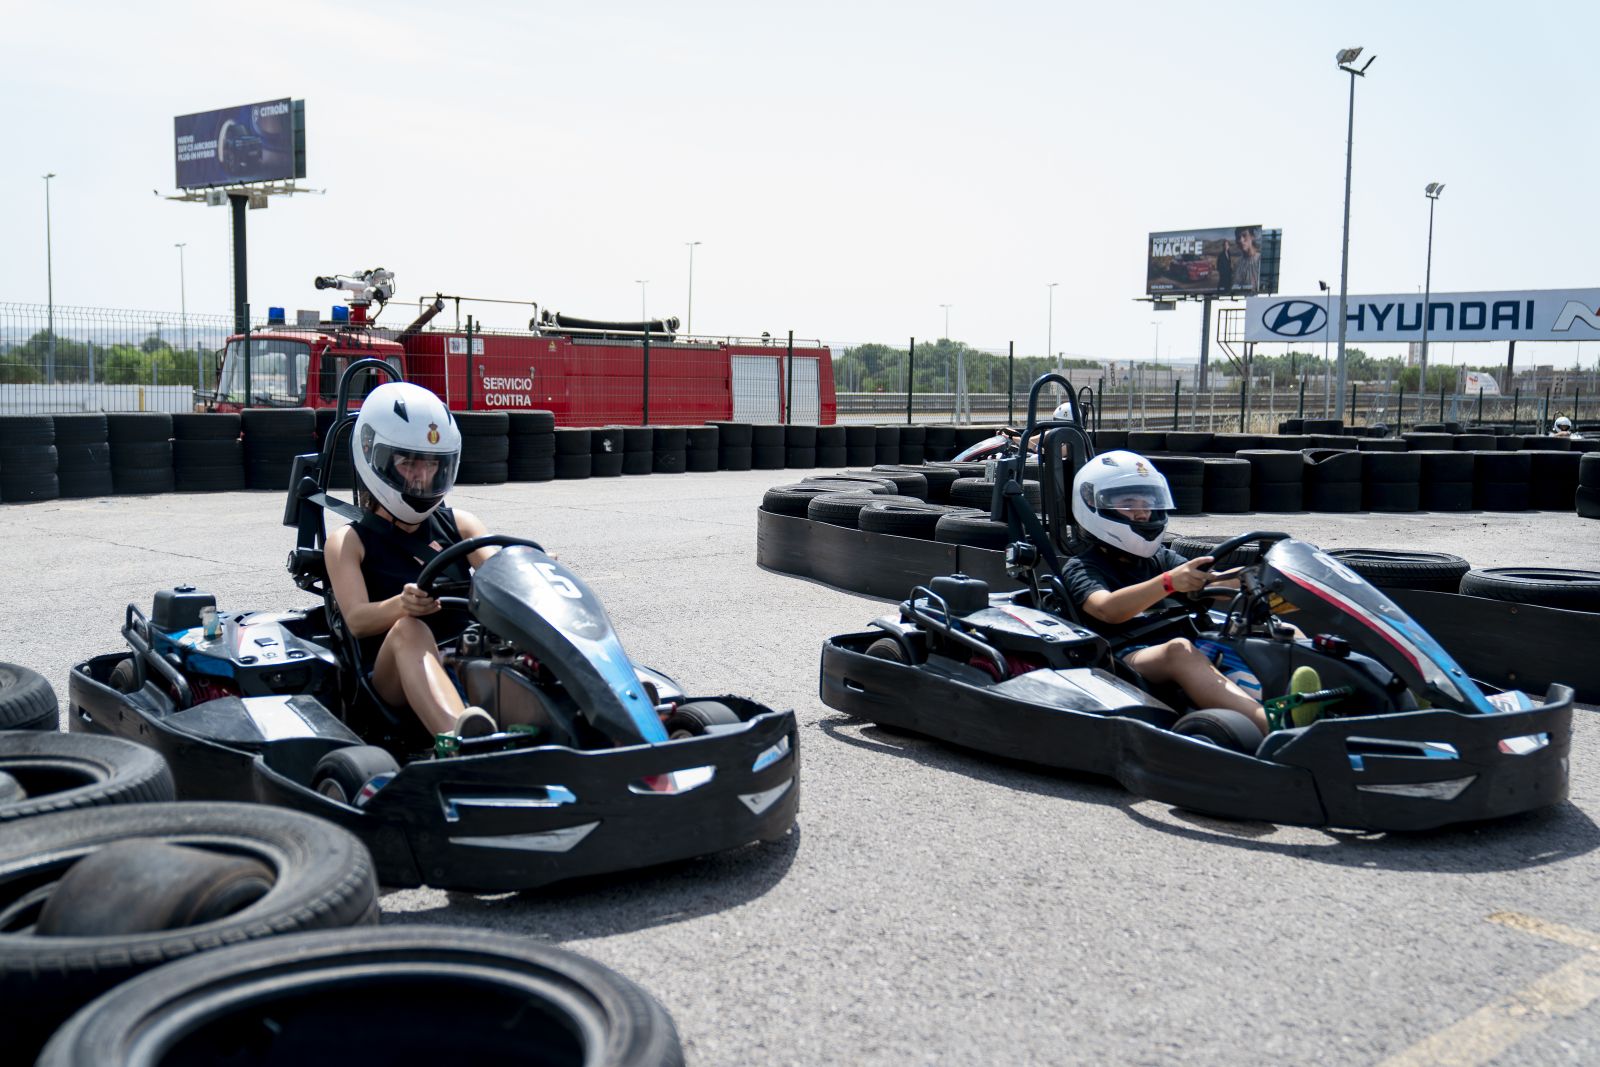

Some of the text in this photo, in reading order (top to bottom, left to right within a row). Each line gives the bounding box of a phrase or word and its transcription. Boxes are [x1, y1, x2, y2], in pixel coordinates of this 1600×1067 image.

[1152, 242, 1203, 256] MACH-E
[1346, 300, 1535, 331] HYUNDAI
[483, 377, 533, 390] SERVICIO
[486, 393, 532, 406] CONTRA
